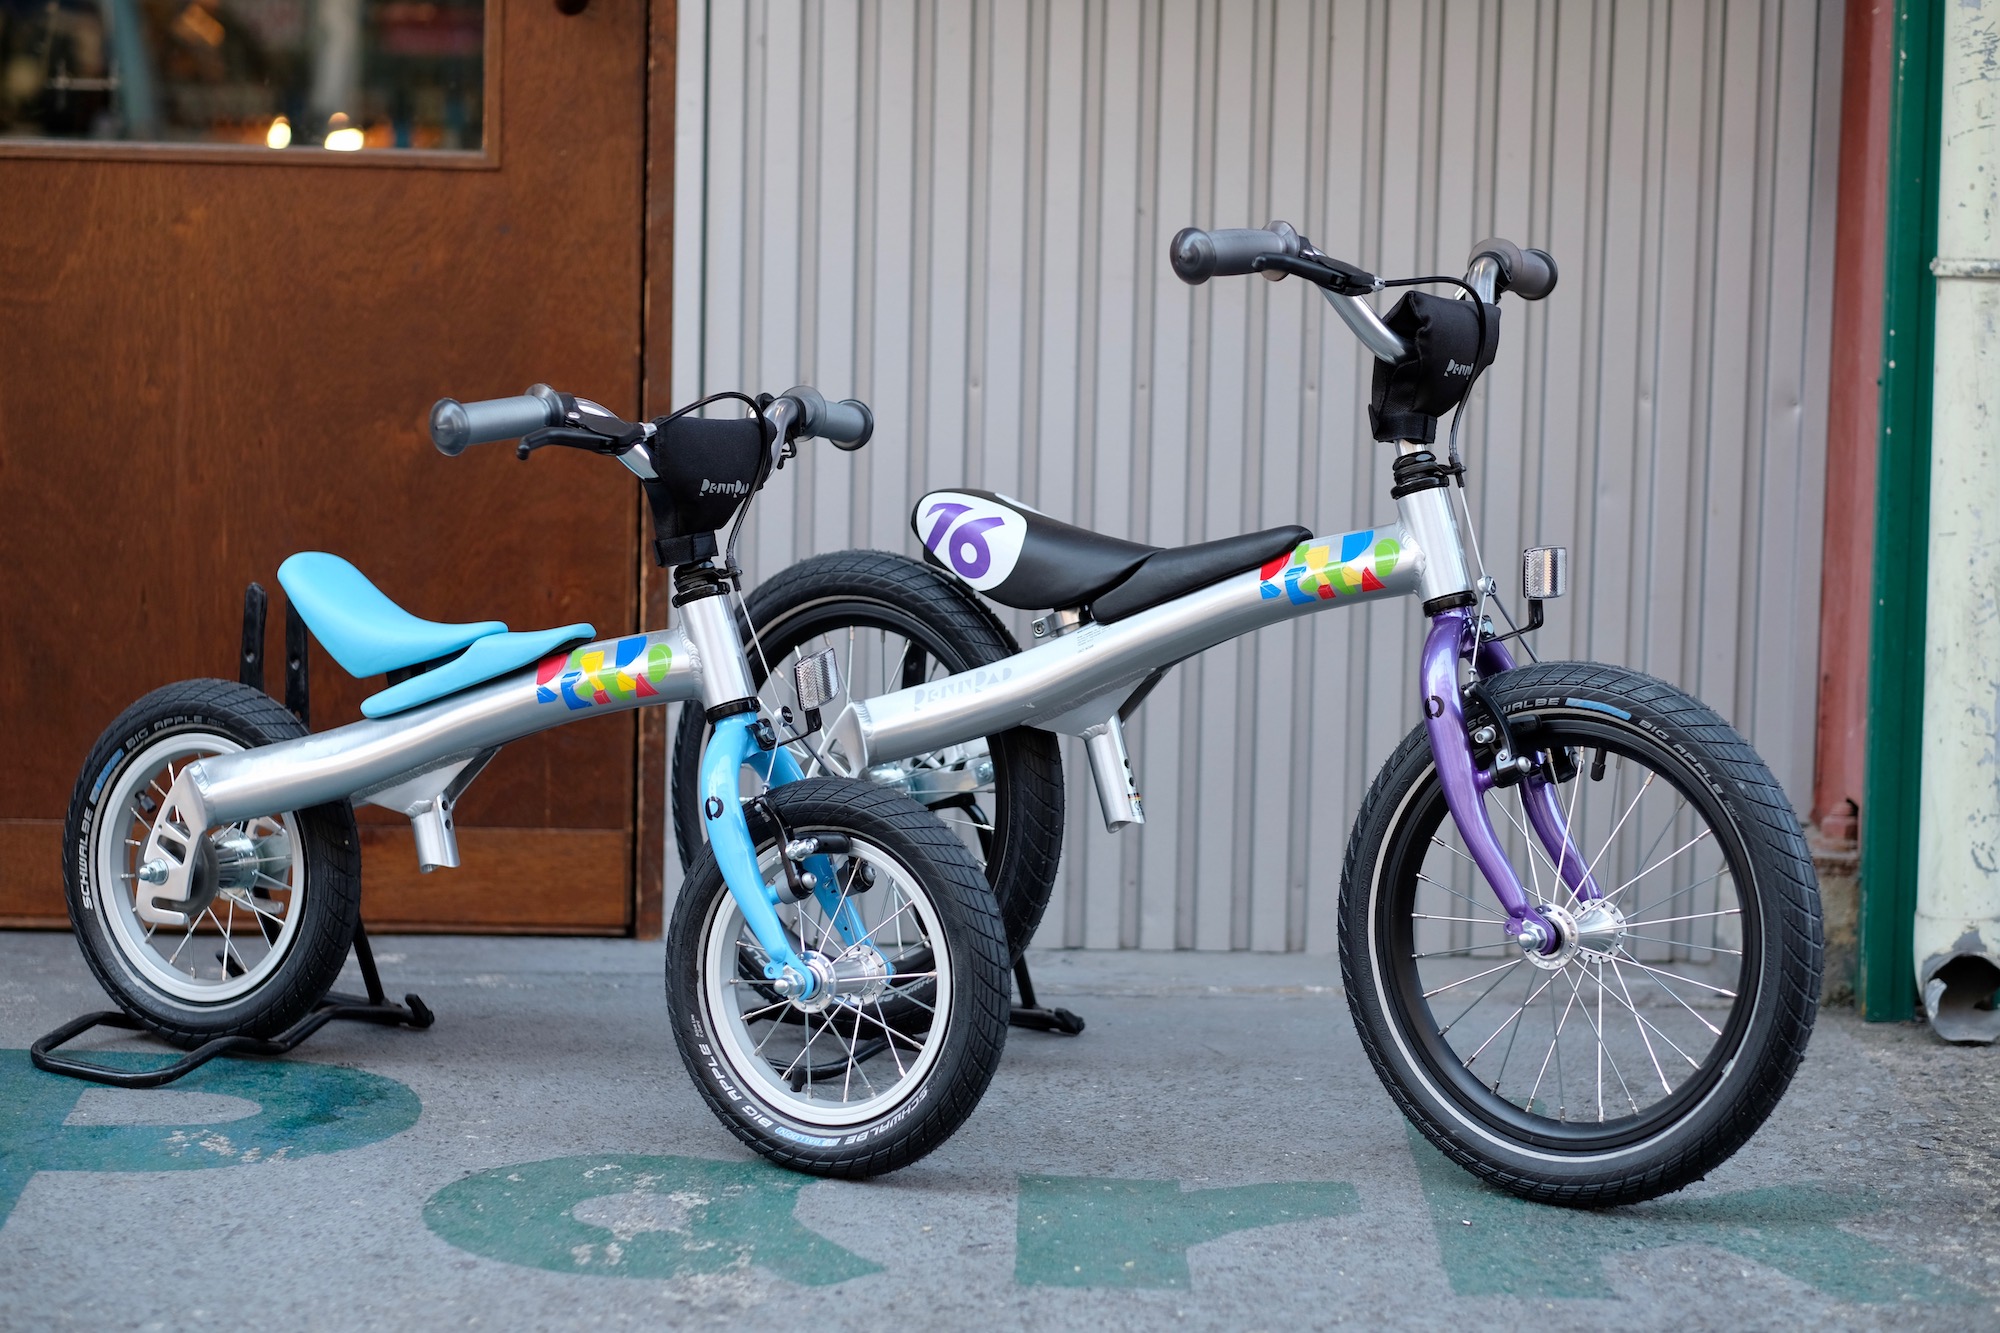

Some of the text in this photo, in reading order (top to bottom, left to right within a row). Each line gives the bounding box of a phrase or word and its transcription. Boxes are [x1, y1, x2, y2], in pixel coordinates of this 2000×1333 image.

[925, 503, 1005, 579] 16
[1638, 719, 1670, 741] BIG
[1673, 743, 1724, 795] APPLE
[78, 715, 203, 910] SCHWALBE BIG APPLE
[698, 1043, 743, 1101] APPLE
[741, 1104, 774, 1128] BIG
[843, 1085, 929, 1146] SCHWALBE
